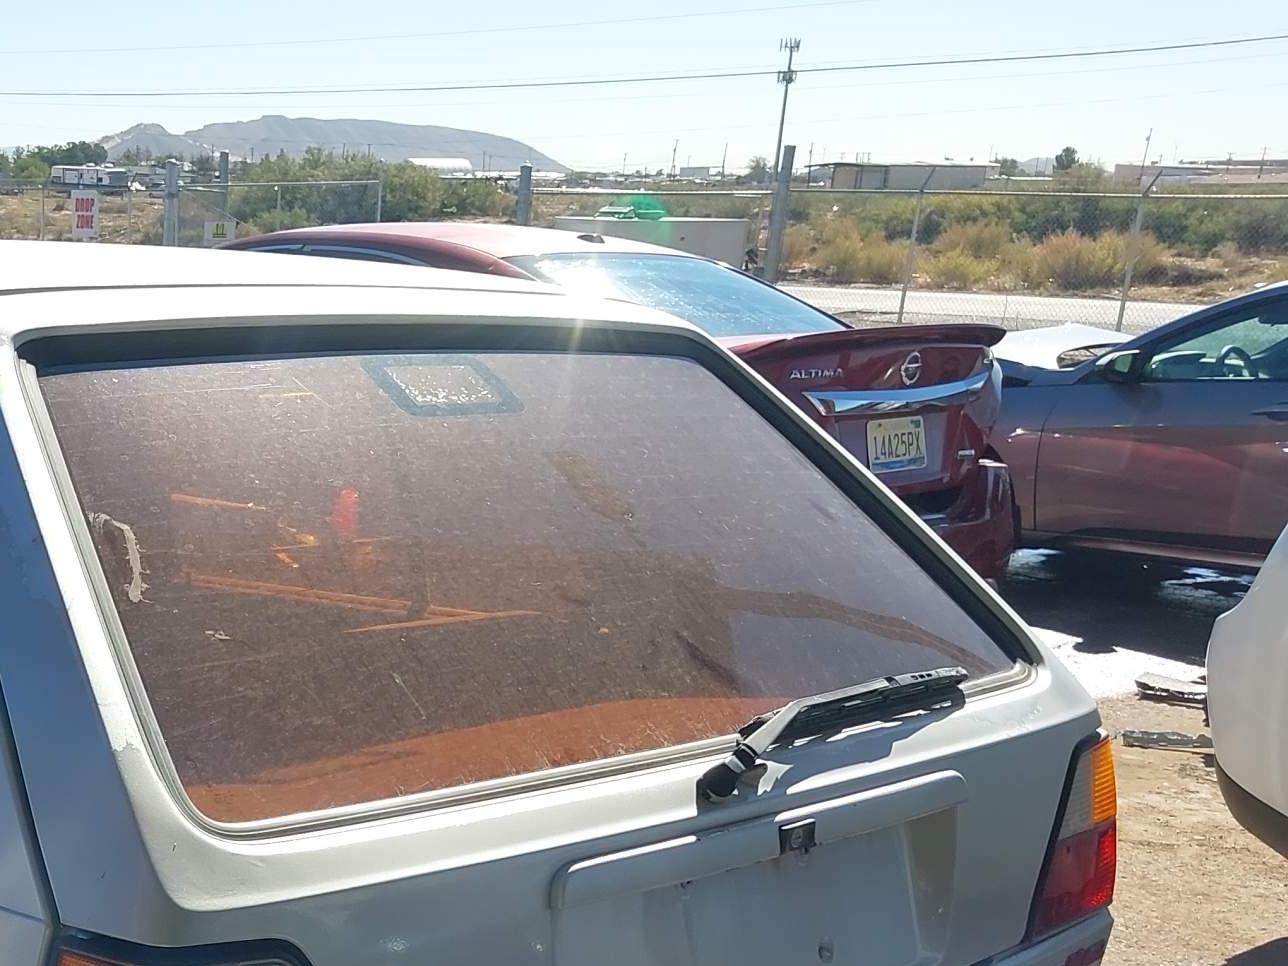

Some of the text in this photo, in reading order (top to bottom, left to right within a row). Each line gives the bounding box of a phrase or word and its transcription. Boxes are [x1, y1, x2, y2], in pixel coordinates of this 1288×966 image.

[75, 198, 95, 212] DROP
[76, 214, 94, 229] ZONE
[790, 367, 844, 380] ALTIMA
[873, 430, 922, 461] 14A25PX
